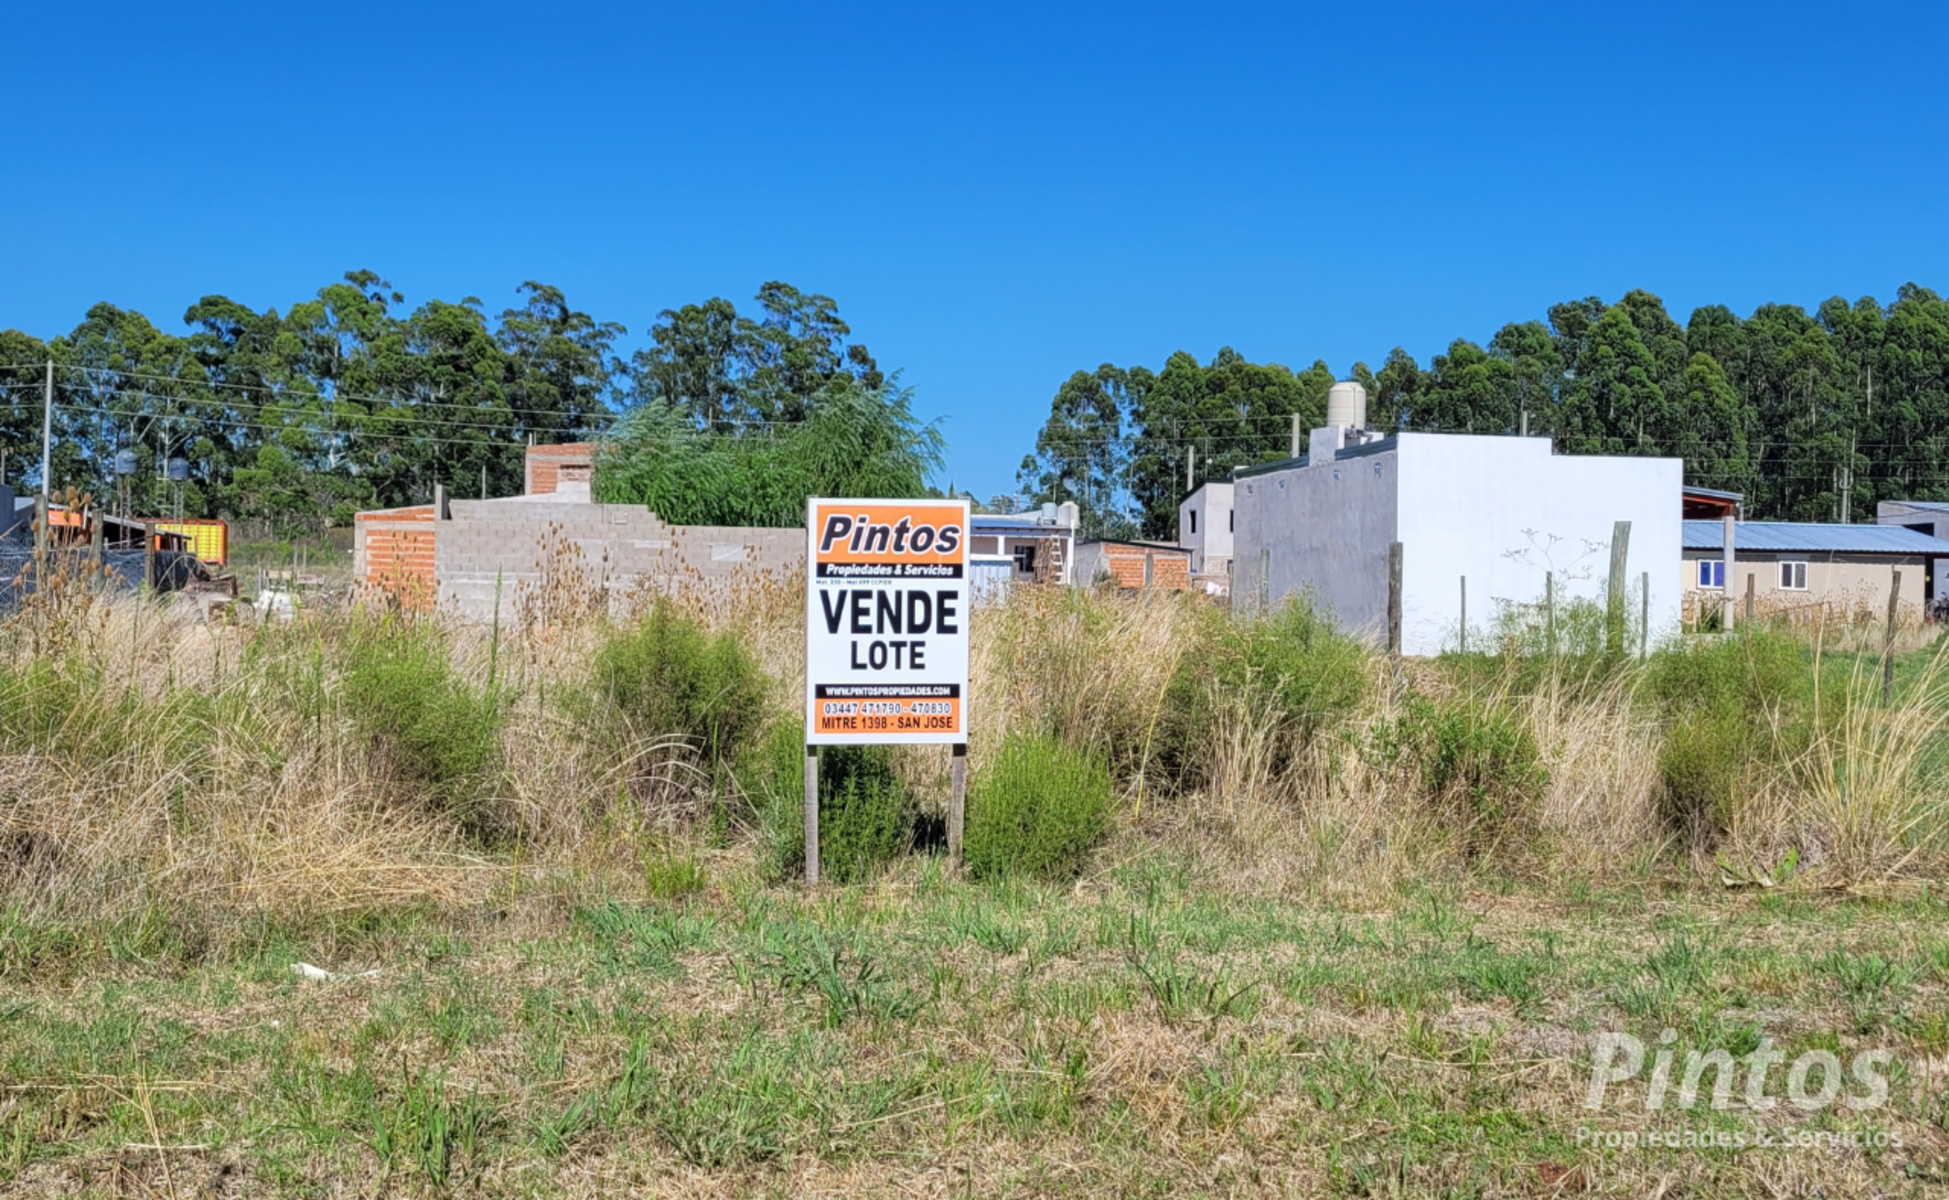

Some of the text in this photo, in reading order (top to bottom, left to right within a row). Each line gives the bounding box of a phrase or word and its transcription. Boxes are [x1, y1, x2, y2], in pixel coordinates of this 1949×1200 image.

[819, 514, 961, 554] Pintos
[826, 564, 953, 576] Propiedades & Servicios
[819, 590, 958, 634] VENDE
[851, 641, 926, 670] LOTE
[824, 702, 858, 715] 03447
[860, 702, 901, 715] 471790
[910, 702, 951, 715] 470830
[822, 717, 857, 729] MITRE
[862, 717, 887, 729] 1398
[897, 717, 920, 728] SAN
[924, 716, 953, 728] JOSE
